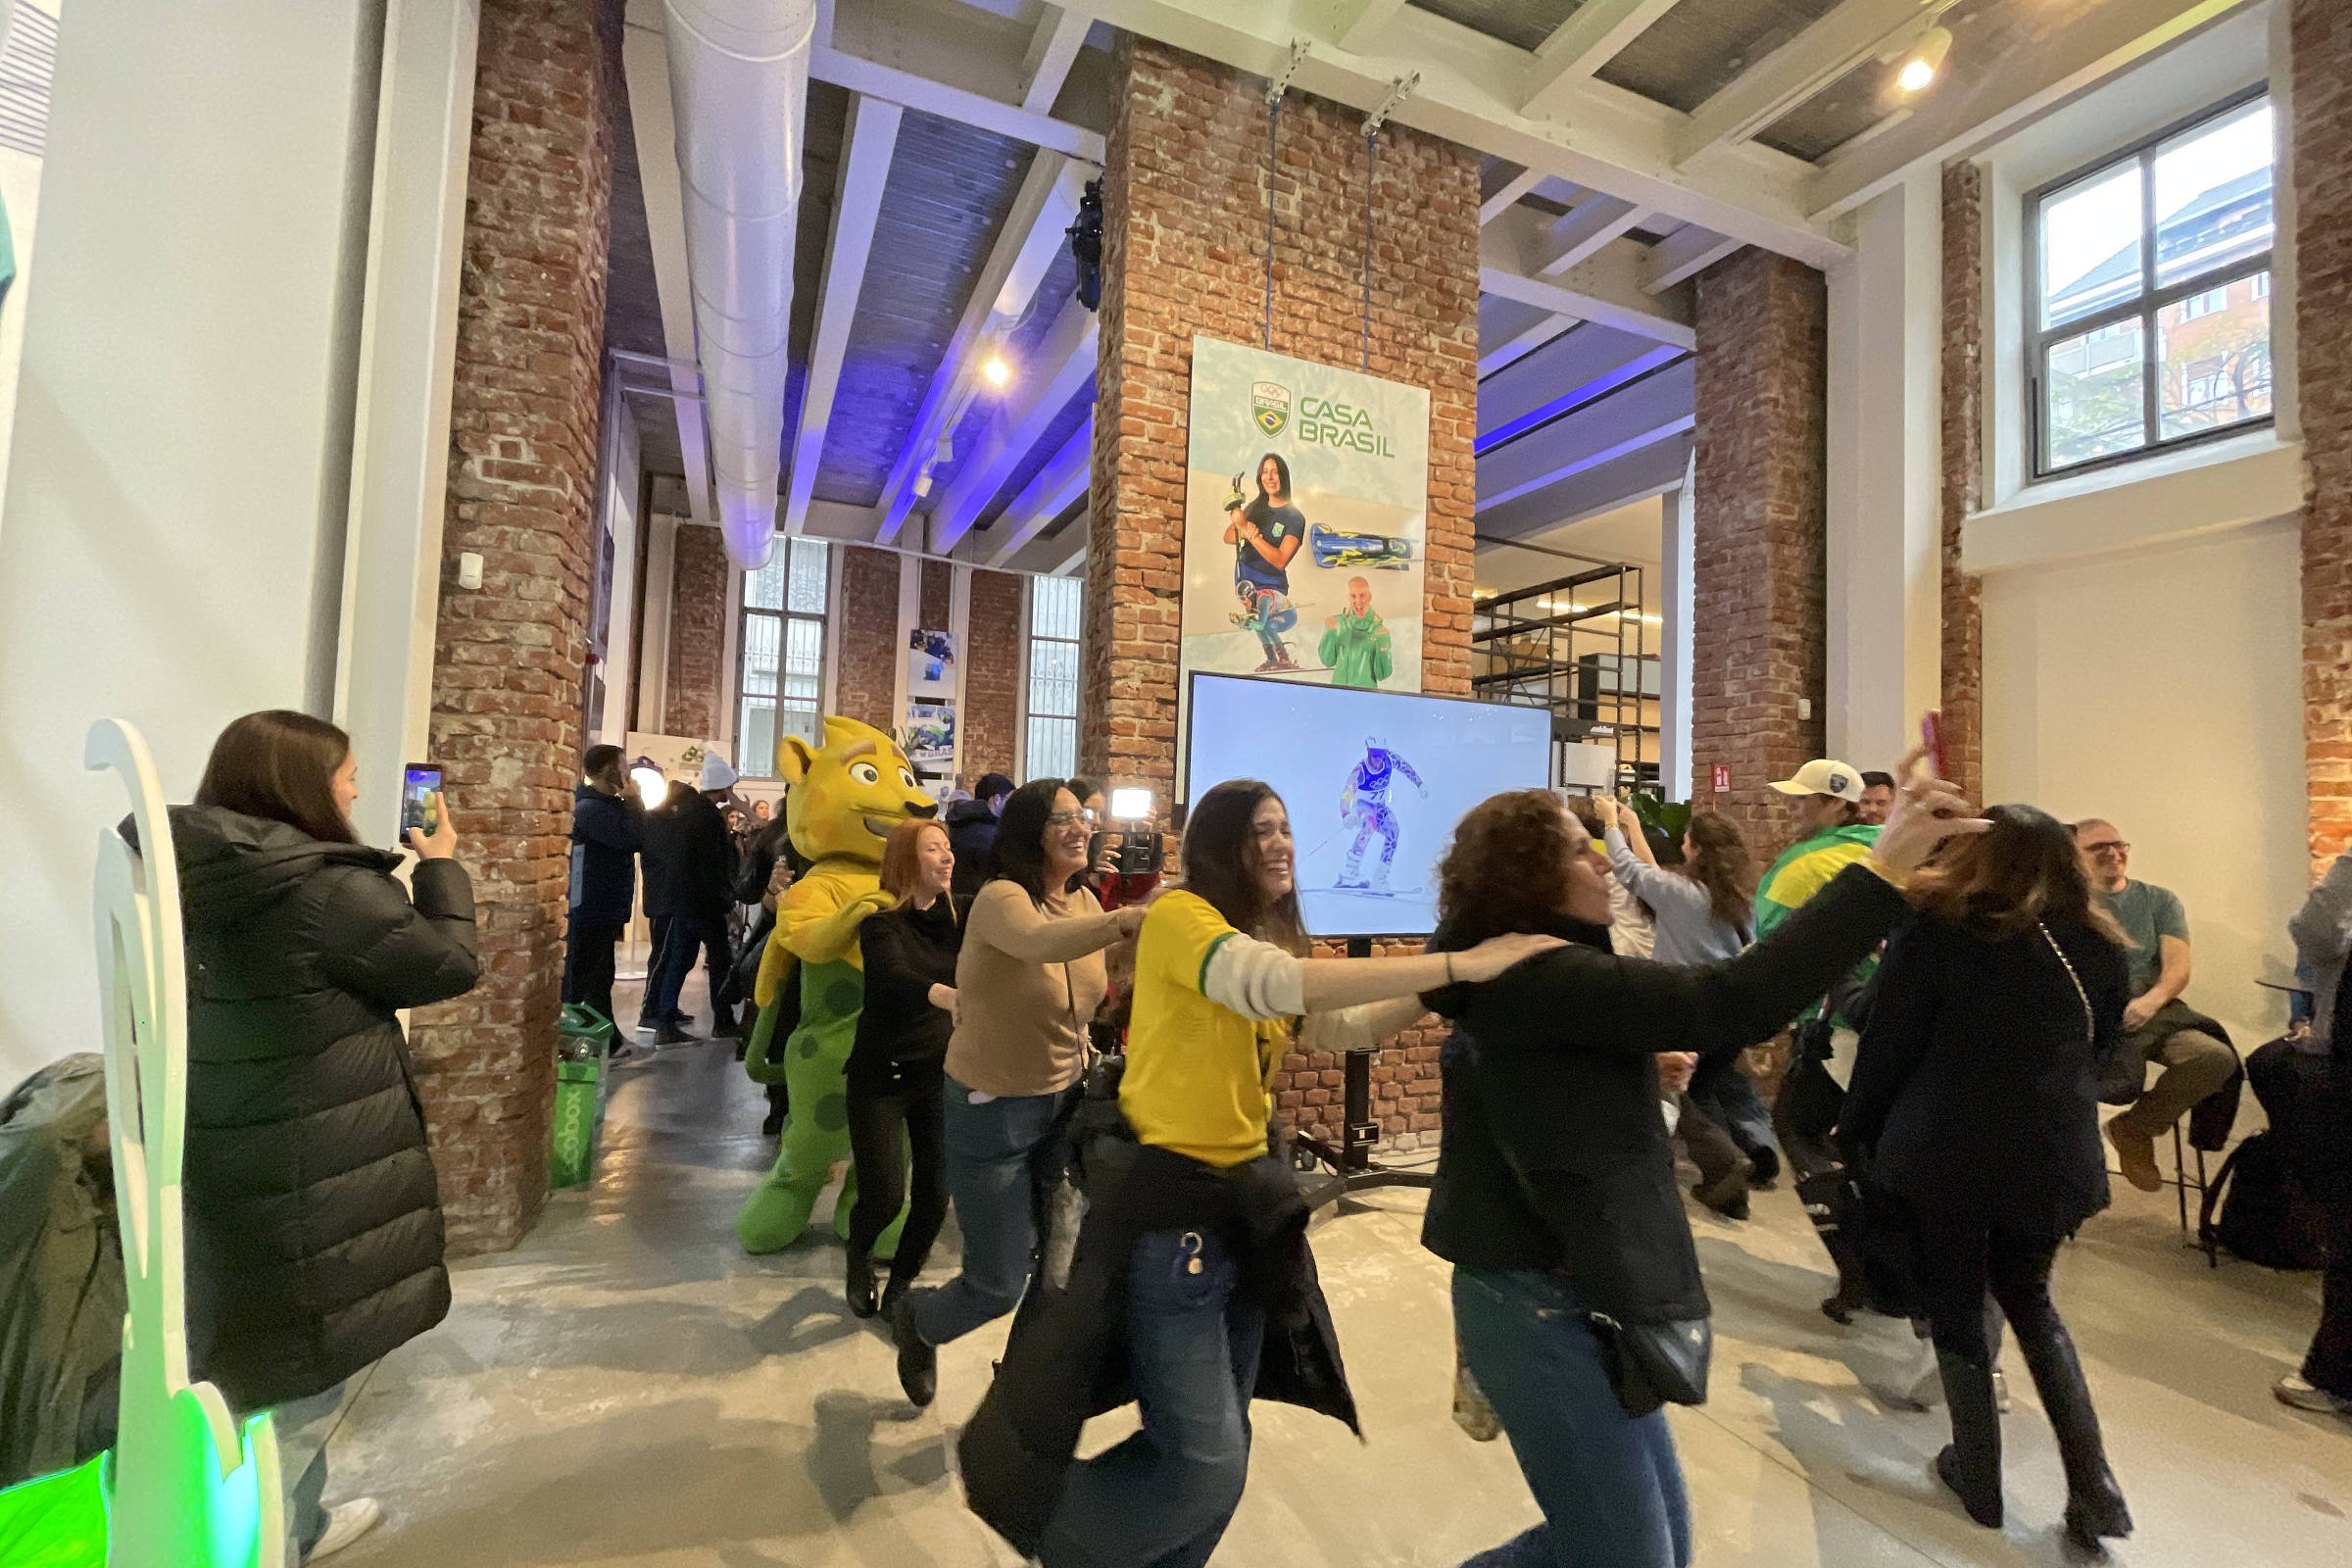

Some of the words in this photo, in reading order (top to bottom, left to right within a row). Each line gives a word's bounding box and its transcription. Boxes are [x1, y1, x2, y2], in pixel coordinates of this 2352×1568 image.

[1254, 396, 1288, 411] BRASIL
[1299, 396, 1374, 431] CASA
[1298, 419, 1396, 459] BRASIL
